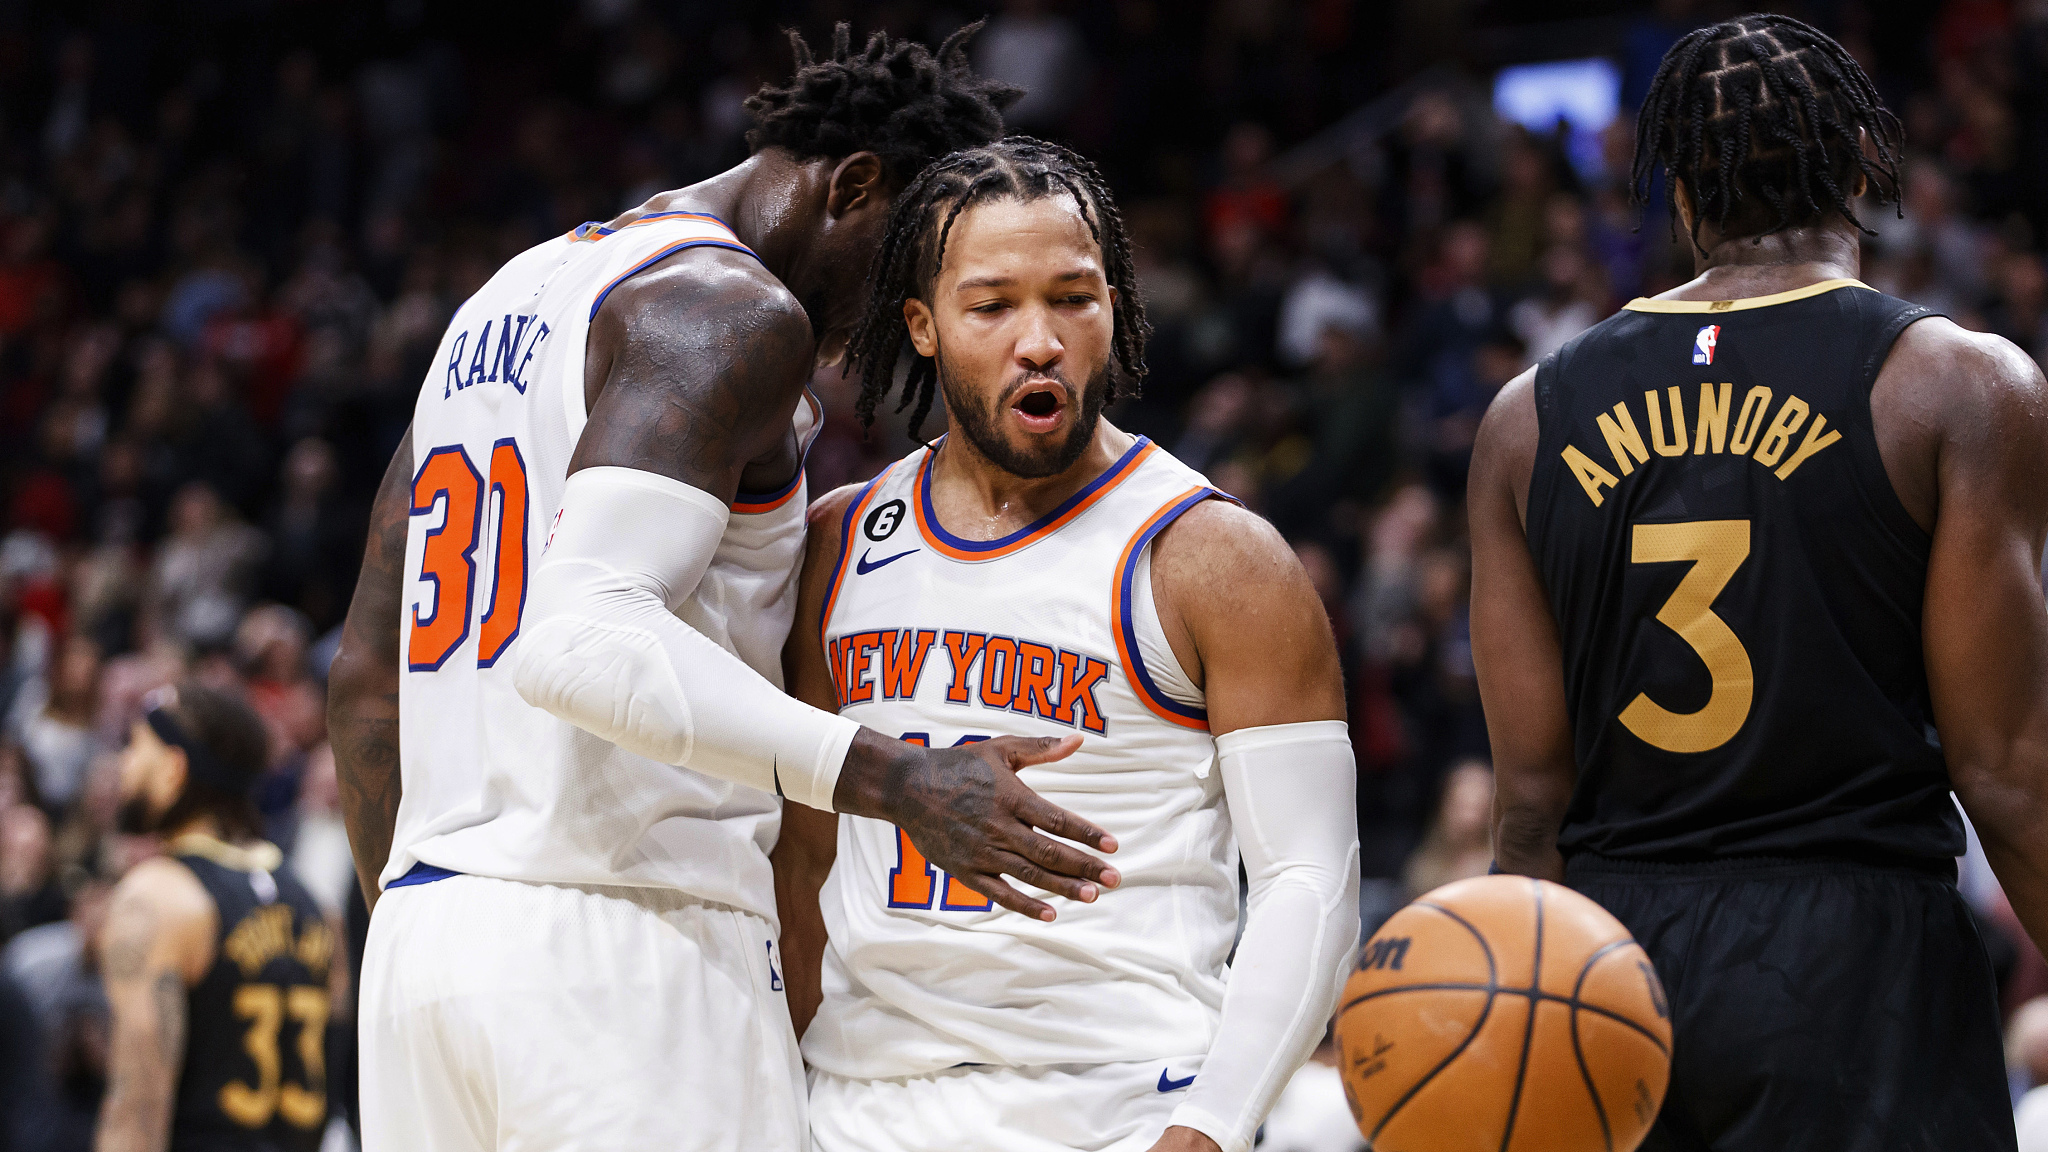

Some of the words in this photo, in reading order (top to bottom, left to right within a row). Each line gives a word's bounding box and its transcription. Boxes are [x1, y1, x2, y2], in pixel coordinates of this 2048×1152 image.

[444, 313, 550, 400] RANE
[1561, 382, 1843, 508] ANUNOBY
[408, 437, 530, 673] 30
[872, 506, 899, 538] 6
[828, 628, 938, 711] NEW
[942, 631, 1111, 738] YORK
[1617, 519, 1754, 753] 3
